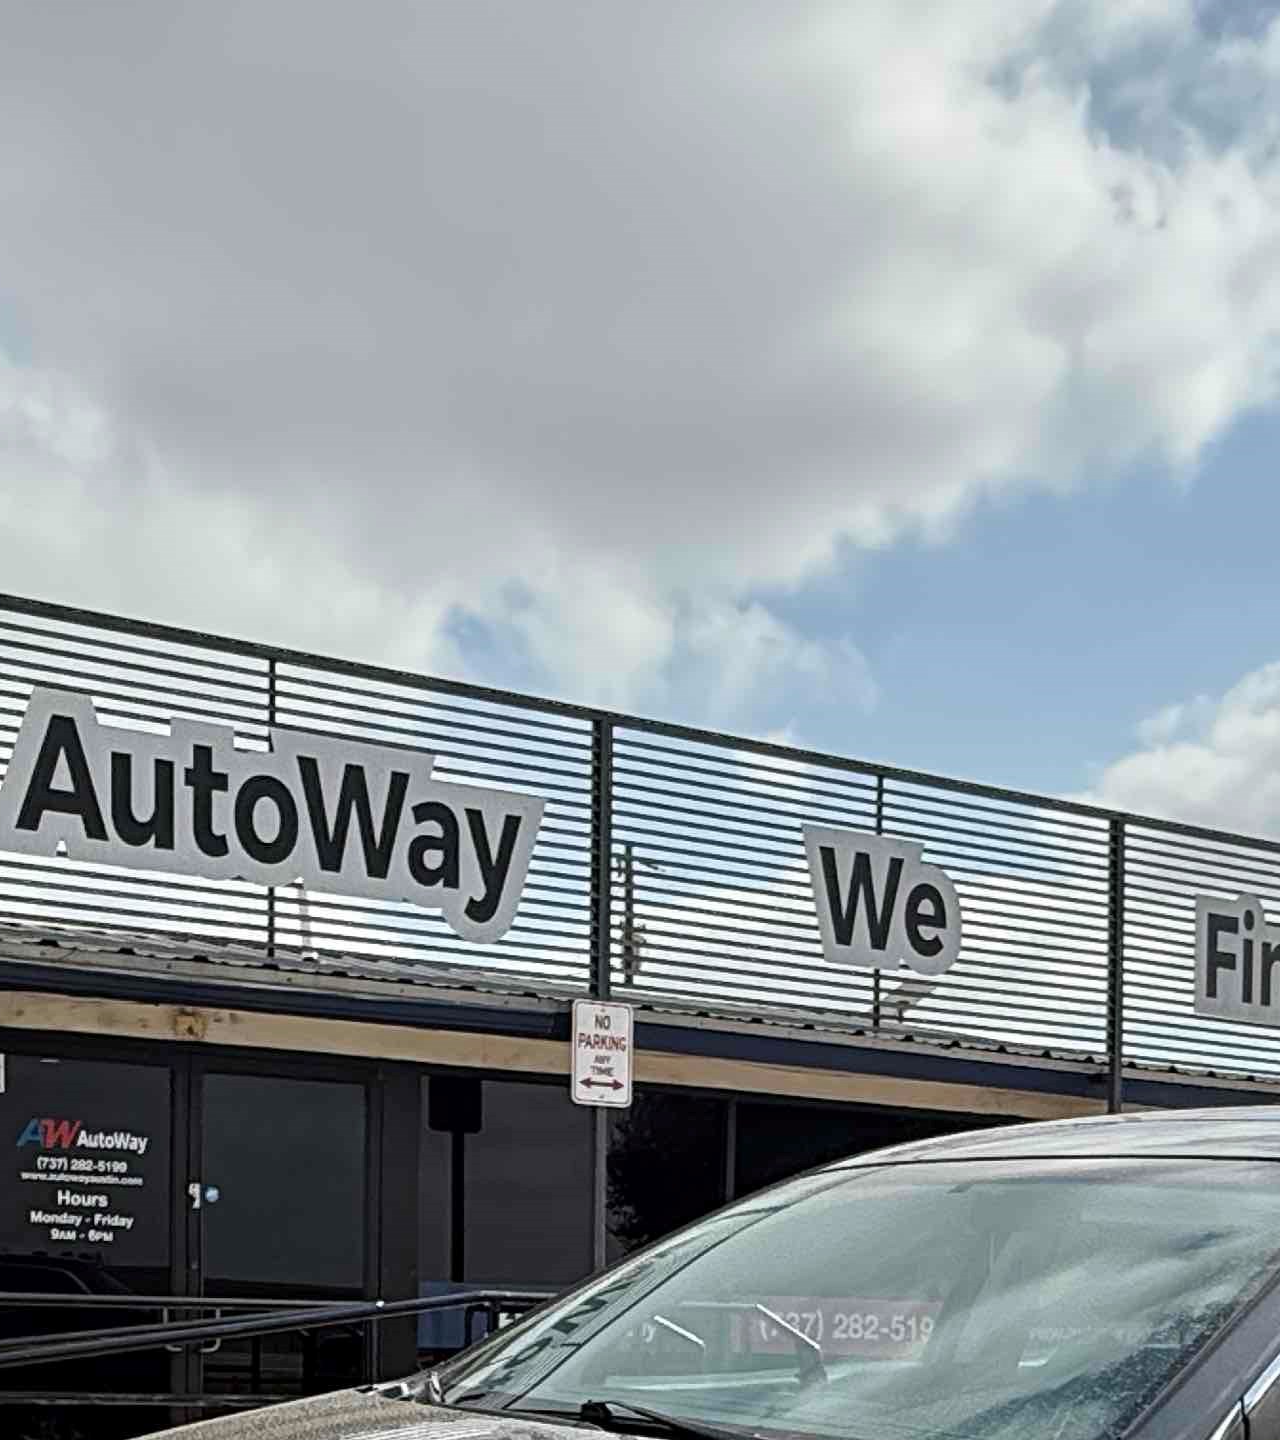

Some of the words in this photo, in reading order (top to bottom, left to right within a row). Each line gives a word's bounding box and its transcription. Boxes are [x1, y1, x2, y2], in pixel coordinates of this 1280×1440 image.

[15, 713, 523, 923] AutoWay
[819, 845, 948, 958] We
[594, 1015, 611, 1030] NO
[578, 1032, 626, 1052] PARKING
[593, 1055, 611, 1065] ANY
[590, 1065, 614, 1077] TIME
[16, 1118, 82, 1149] AW
[76, 1130, 149, 1155] AutoWay
[36, 1156, 68, 1171] (737)
[57, 1190, 109, 1208] Hours
[30, 1211, 82, 1226] Monday
[93, 1213, 134, 1229] Friday
